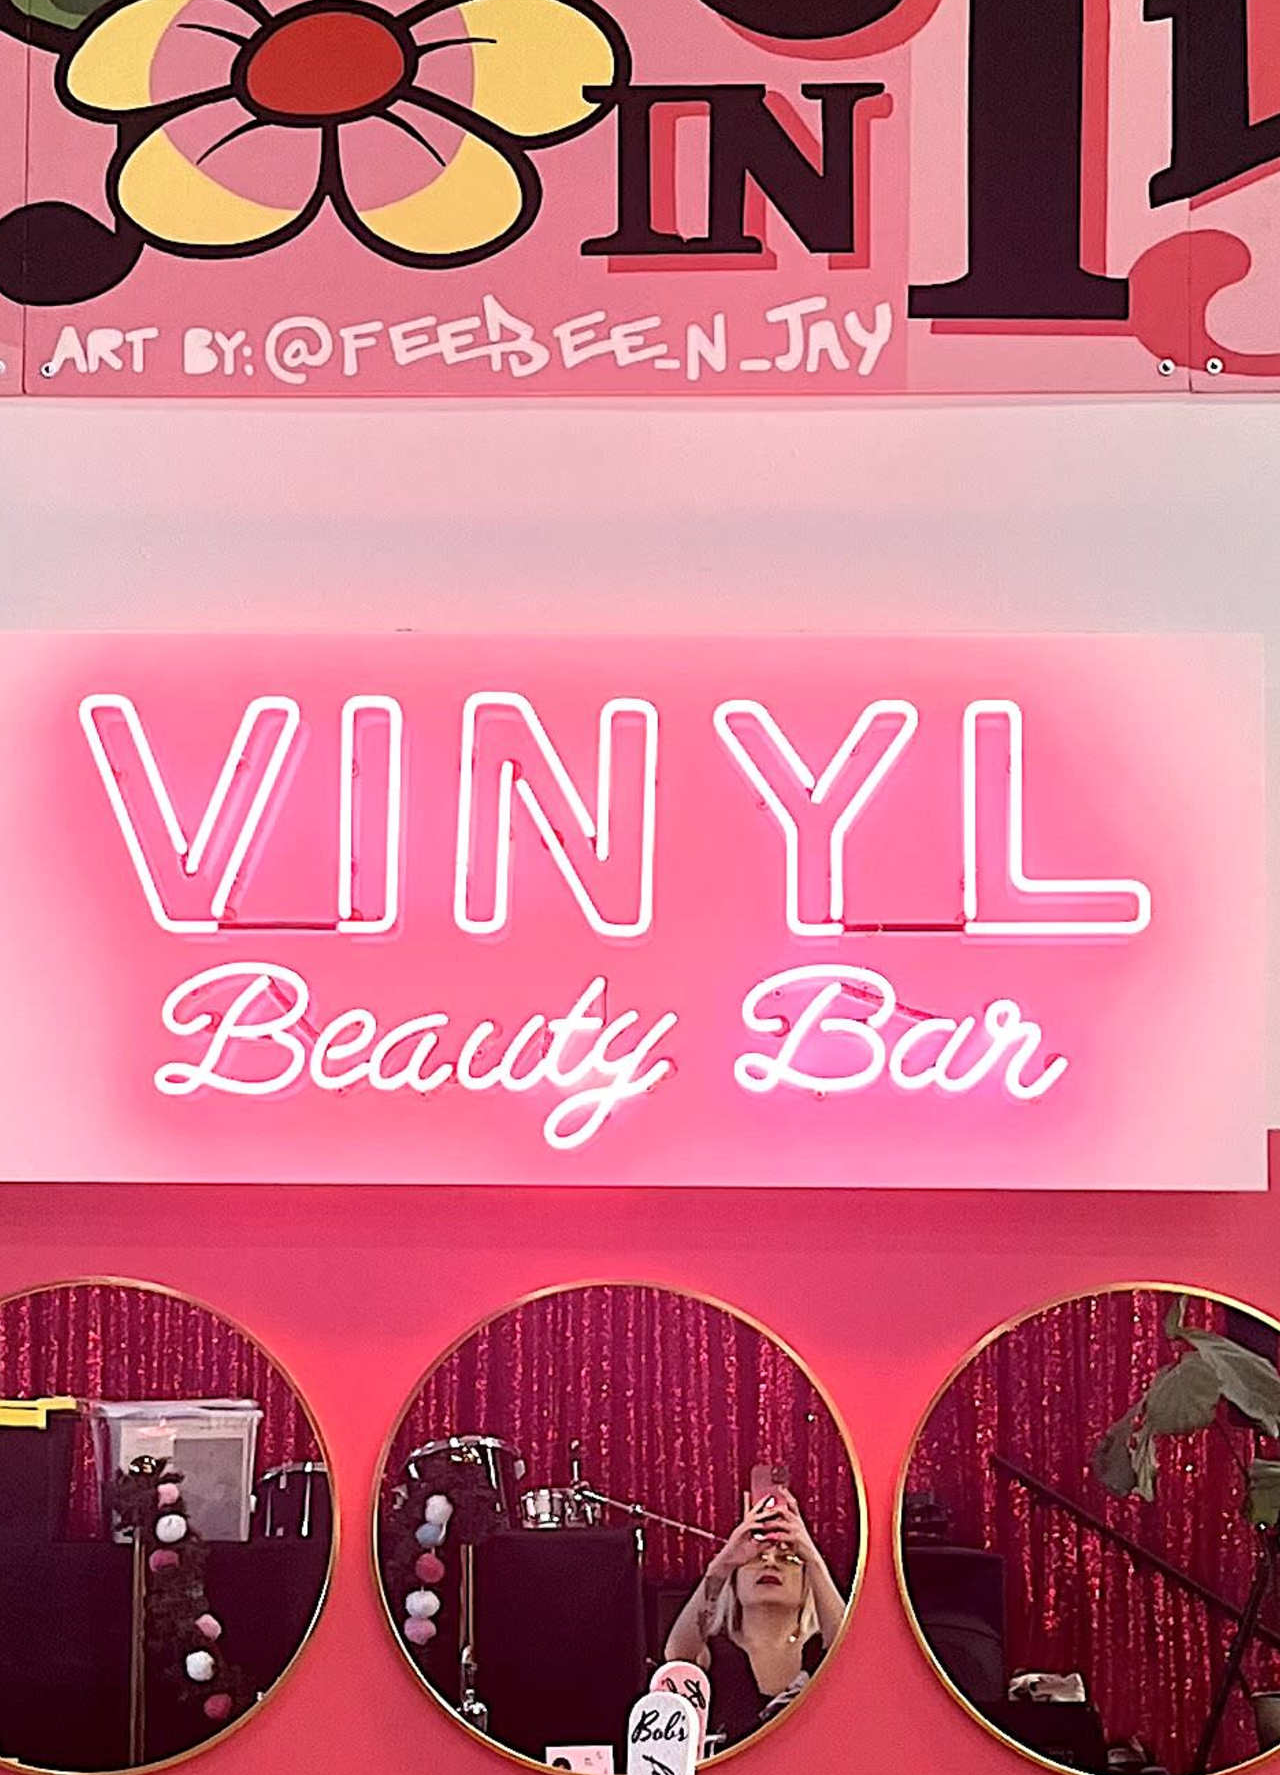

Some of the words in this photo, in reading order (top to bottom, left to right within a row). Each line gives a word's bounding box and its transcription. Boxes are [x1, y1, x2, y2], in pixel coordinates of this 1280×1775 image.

[581, 82, 894, 272] IN
[52, 326, 159, 375] ART
[78, 690, 1152, 937] VINYL
[153, 961, 678, 1150] Beauty
[733, 963, 1068, 1101] Bar
[631, 1709, 689, 1744] Bob's
